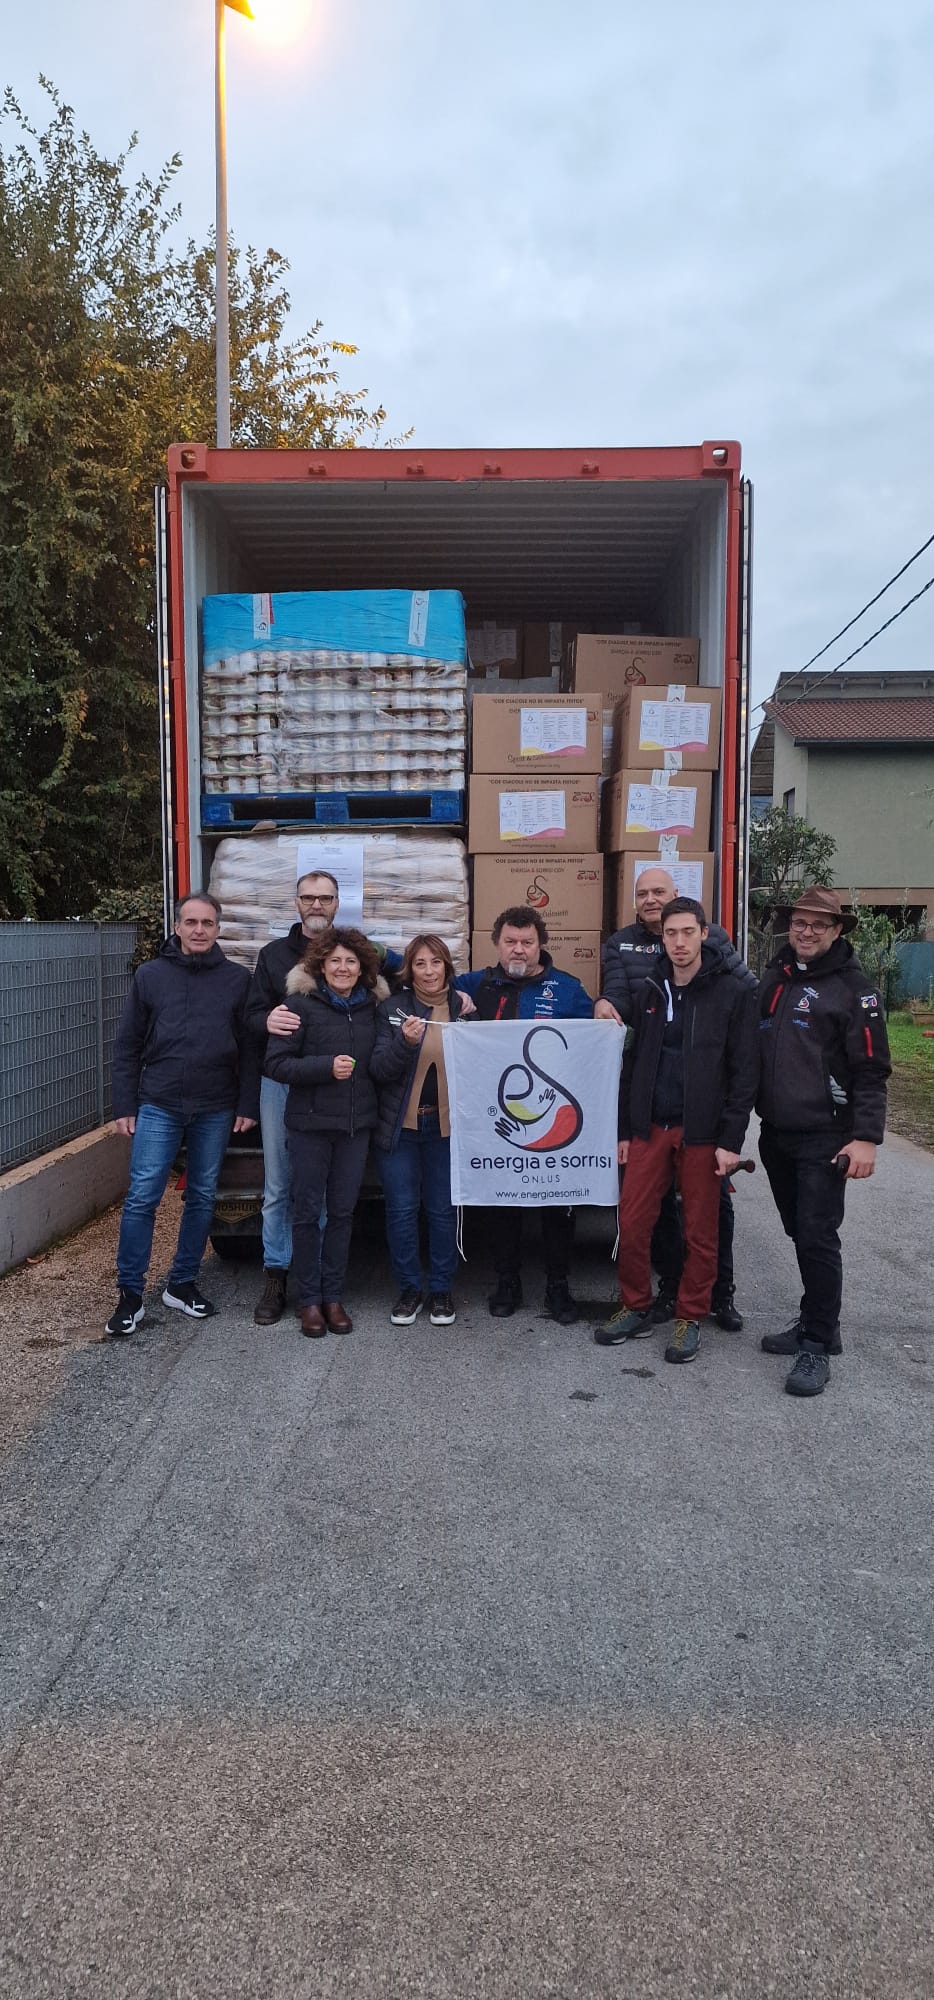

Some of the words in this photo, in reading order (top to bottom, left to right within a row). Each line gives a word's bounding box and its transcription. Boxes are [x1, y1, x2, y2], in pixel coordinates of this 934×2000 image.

[470, 1156, 540, 1174] energia
[545, 1156, 557, 1169] e
[561, 1155, 612, 1169] sorrisi
[521, 1174, 561, 1184] ONLUS
[495, 1187, 590, 1200] www.energiaesorrisi.it
